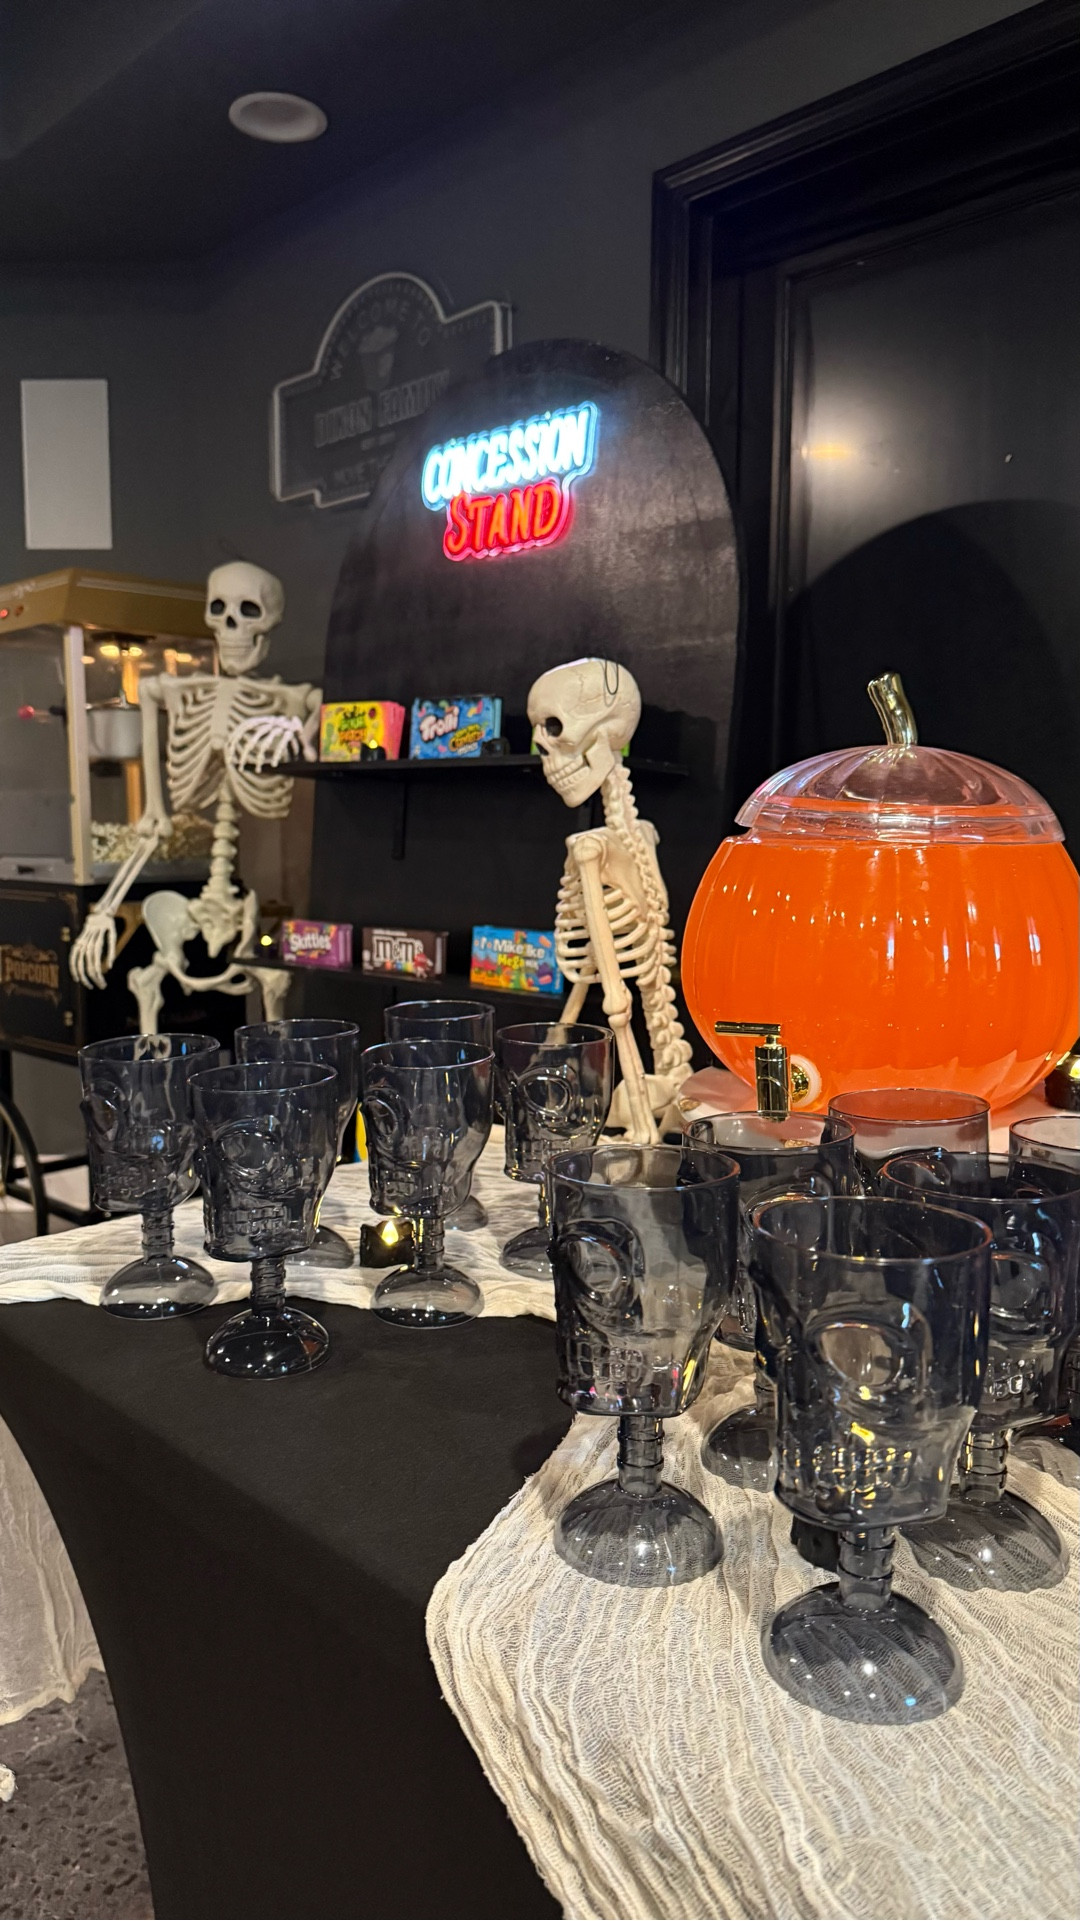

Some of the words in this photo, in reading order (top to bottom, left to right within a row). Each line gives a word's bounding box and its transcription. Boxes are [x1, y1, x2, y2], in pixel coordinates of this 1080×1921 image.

[423, 406, 593, 504] CONCESSION
[444, 481, 562, 553] STAND
[419, 705, 460, 742] Trolli
[289, 932, 332, 952] Skittles
[493, 939, 524, 955] Mike
[4, 956, 59, 989] POPCORN
